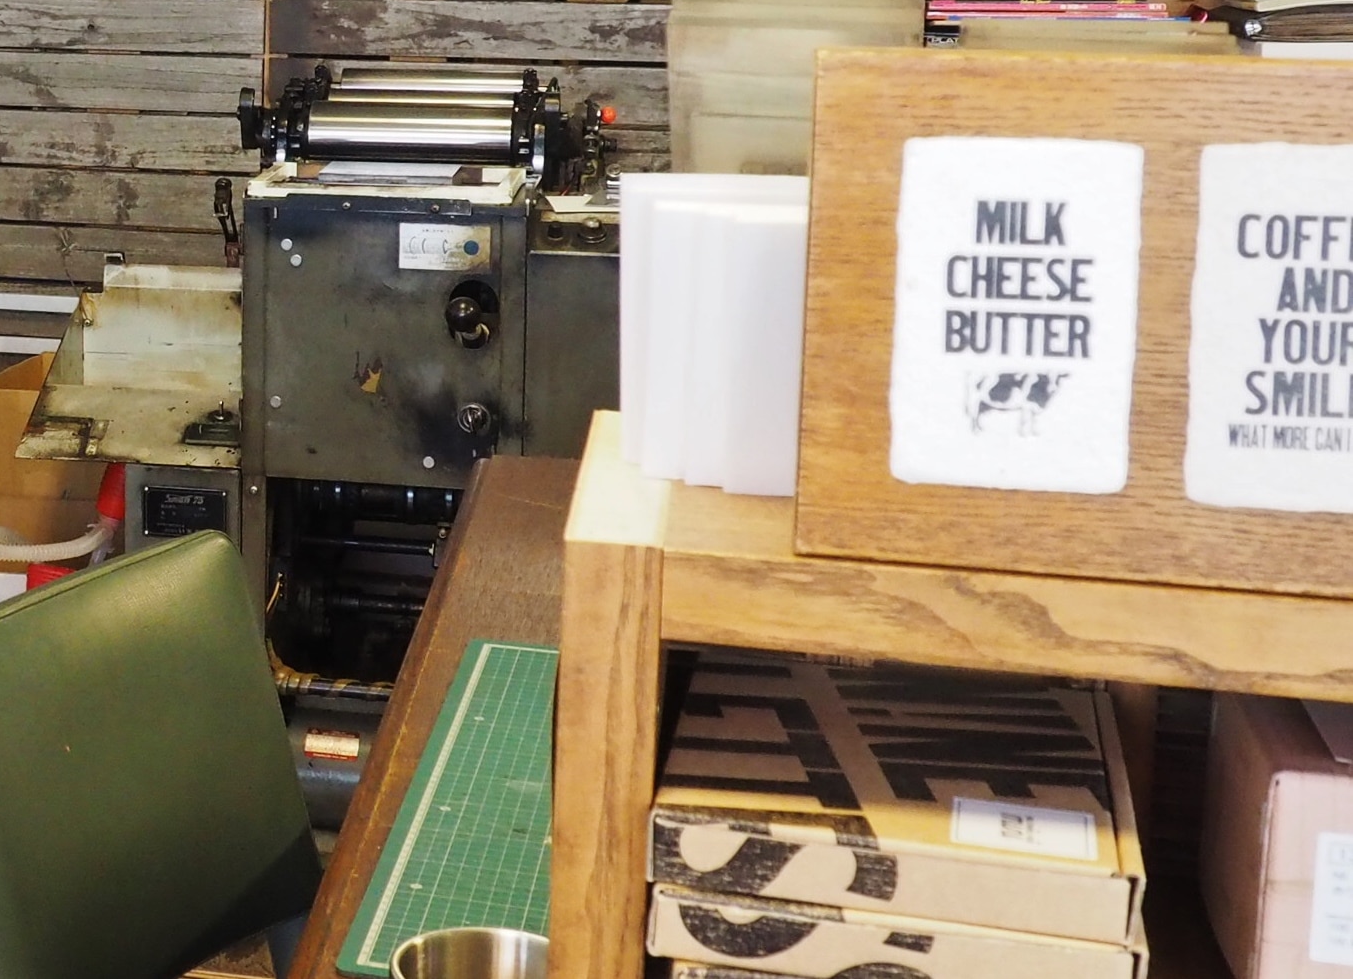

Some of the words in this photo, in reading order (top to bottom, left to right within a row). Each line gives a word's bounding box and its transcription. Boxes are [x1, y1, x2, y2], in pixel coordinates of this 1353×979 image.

[975, 200, 1067, 246] MILK
[1236, 213, 1353, 262] COFF
[946, 254, 1093, 303] CHEESE
[945, 310, 1090, 359] BUTTER
[1244, 369, 1353, 419] SMIL
[1228, 423, 1268, 450] WHAT
[1272, 424, 1310, 451] MORE
[1314, 425, 1343, 452] CAN
